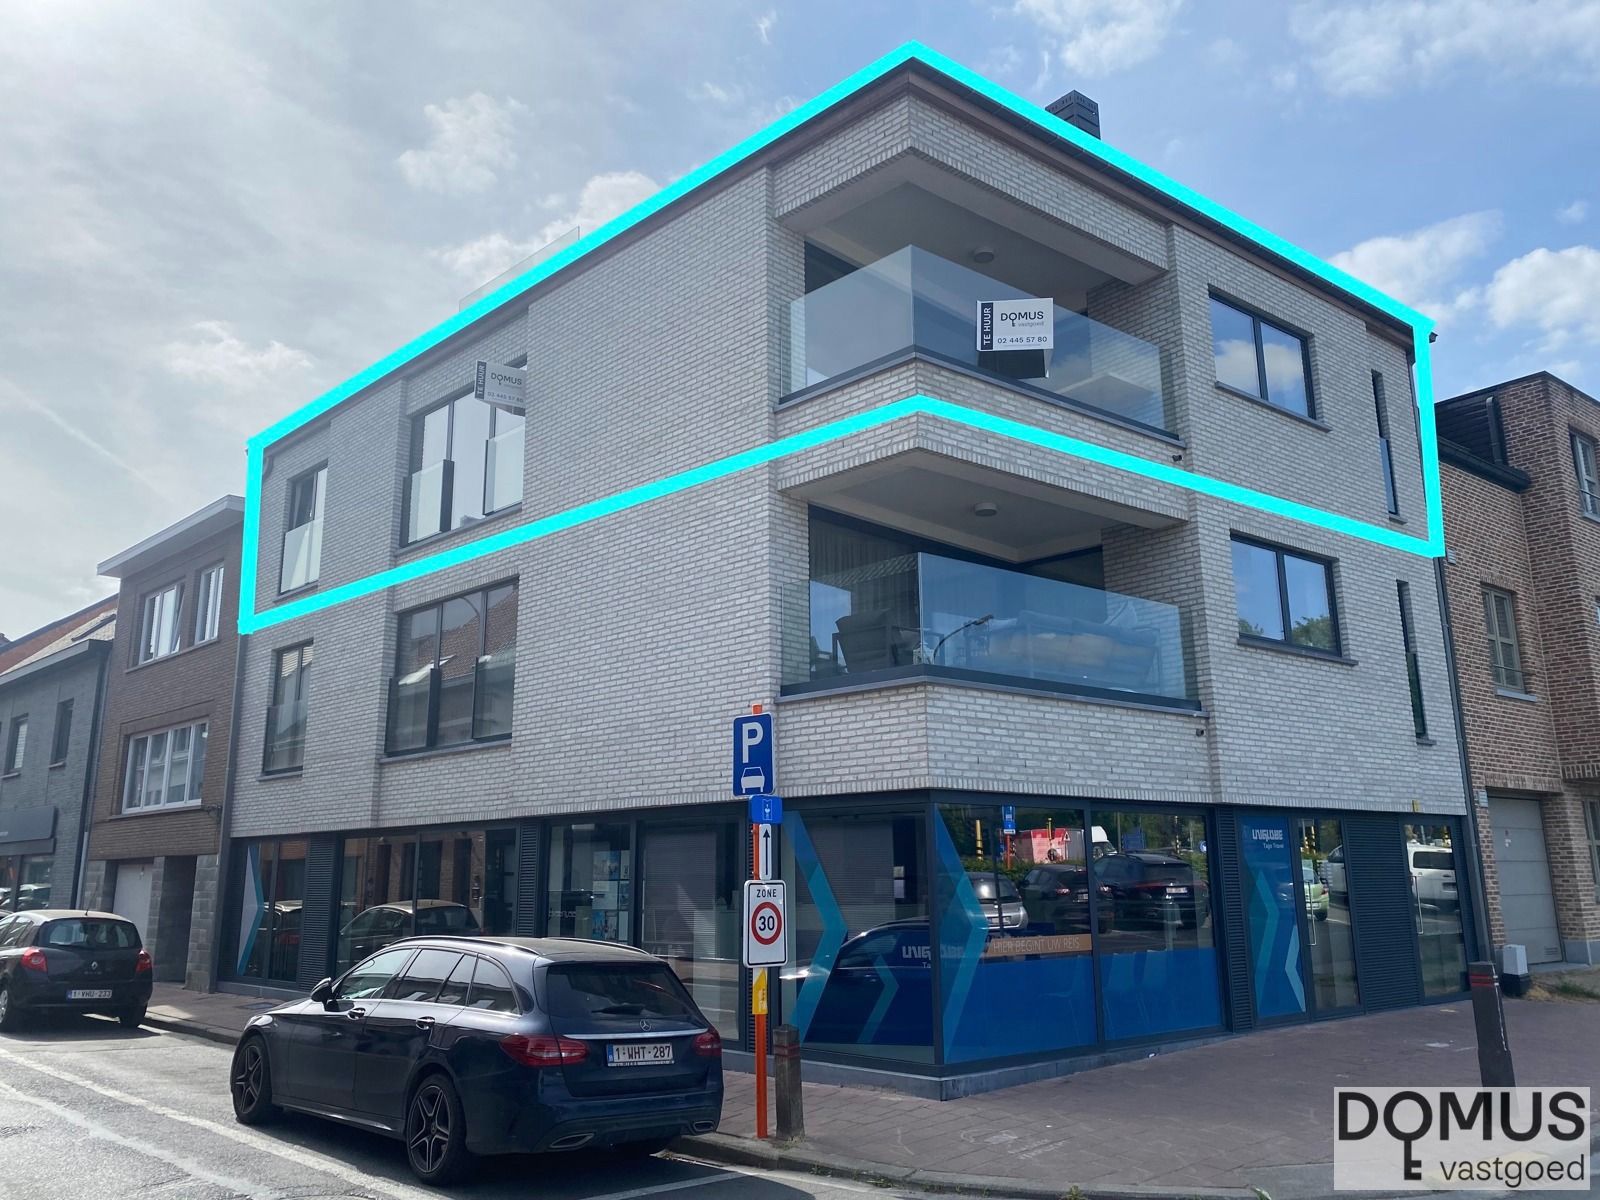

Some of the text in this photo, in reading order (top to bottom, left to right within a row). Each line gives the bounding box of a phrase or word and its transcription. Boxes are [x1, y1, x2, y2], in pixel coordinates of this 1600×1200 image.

[1000, 311, 1044, 323] DOMUS
[984, 334, 991, 345] TE
[490, 372, 522, 386] DOMUS
[742, 722, 763, 763] P
[756, 889, 777, 898] ZONE
[759, 915, 775, 931] 30
[993, 936, 1080, 953] HIER BEGINT UW REIS
